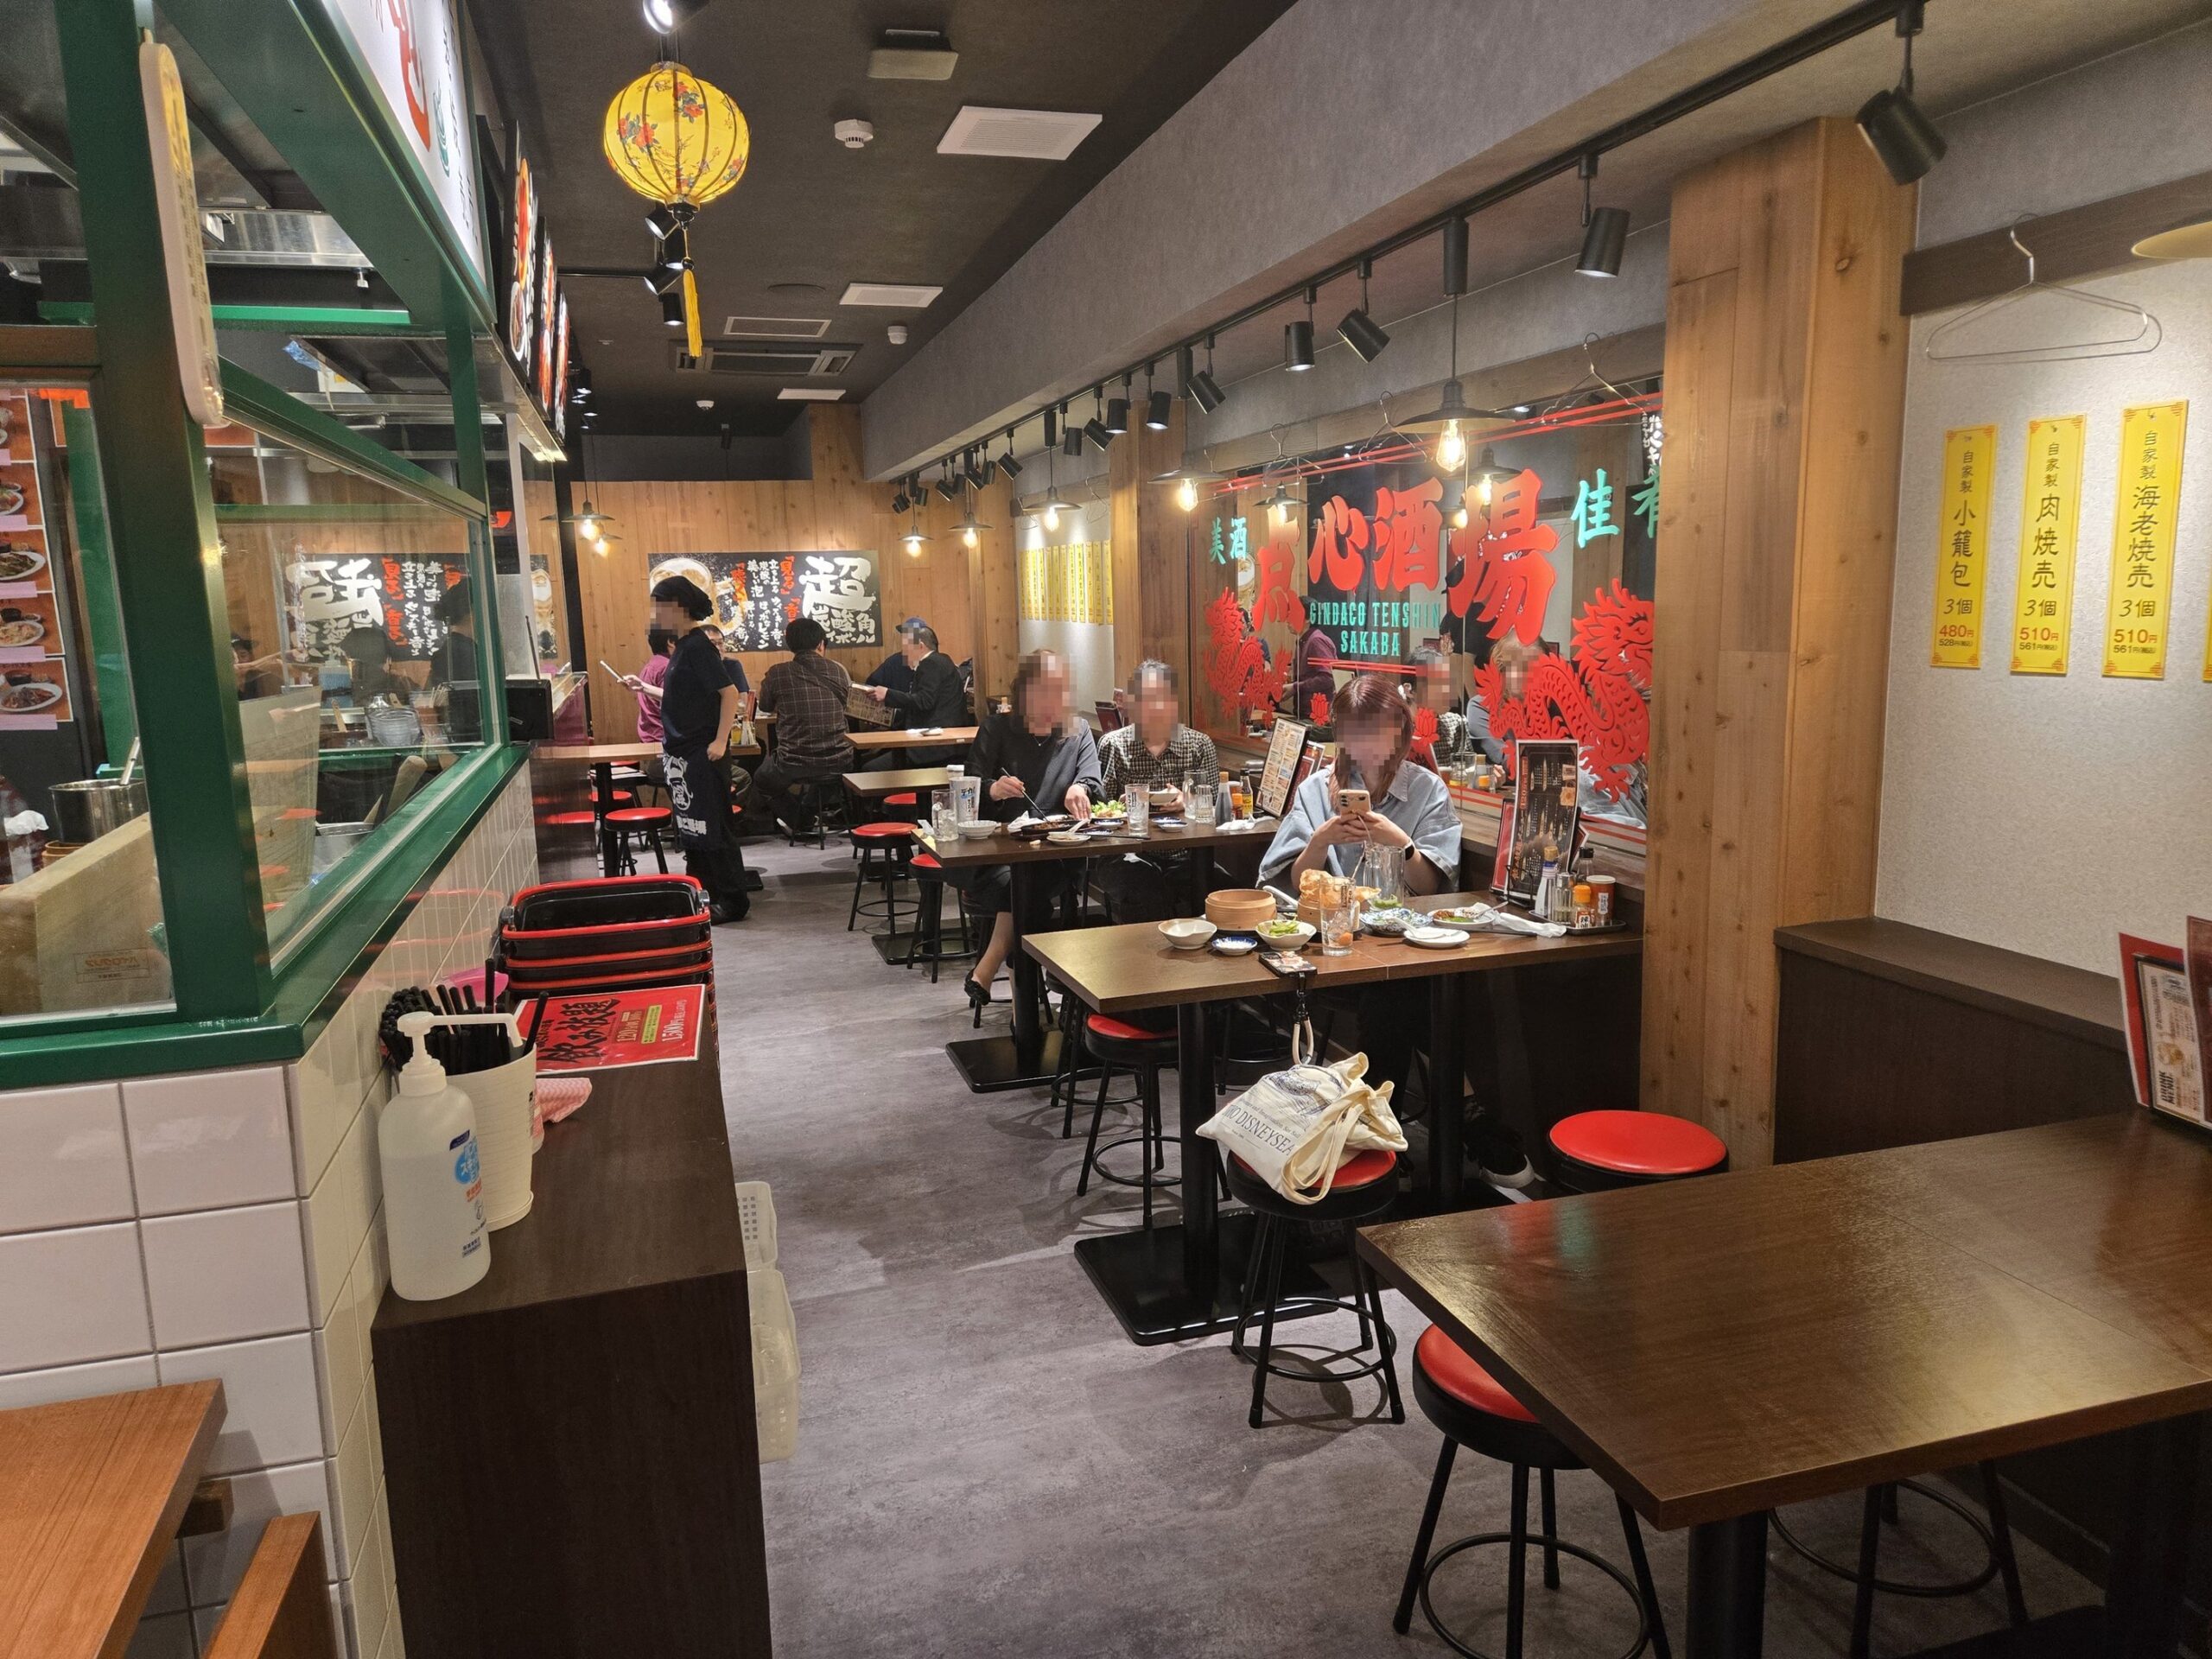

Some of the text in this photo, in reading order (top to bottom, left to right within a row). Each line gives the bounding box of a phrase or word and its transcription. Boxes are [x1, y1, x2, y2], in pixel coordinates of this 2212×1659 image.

[1959, 449, 1974, 493] 自家製
[2043, 442, 2061, 487] 自家製
[2139, 430, 2158, 480] 自家製
[1210, 517, 1247, 565] 美酒
[1252, 468, 1559, 645] 点心酒場
[1950, 499, 1977, 588] 小籠包
[2031, 493, 2061, 589] 肉焼売
[2126, 485, 2160, 589] 海老焼売
[798, 555, 876, 618] 超
[1943, 598, 1974, 615] 3個
[2024, 599, 2057, 617] 3個
[2119, 599, 2156, 618] 3個
[1310, 601, 1441, 628] GINDACO TENSHIN
[1939, 625, 1974, 638] 480円
[2019, 627, 2059, 641] 510円
[2113, 629, 2158, 644] 510円
[1341, 630, 1401, 657] SAKABA
[537, 999, 620, 1063] 飲み放題
[1236, 1110, 1296, 1156] DISNEYSEA
